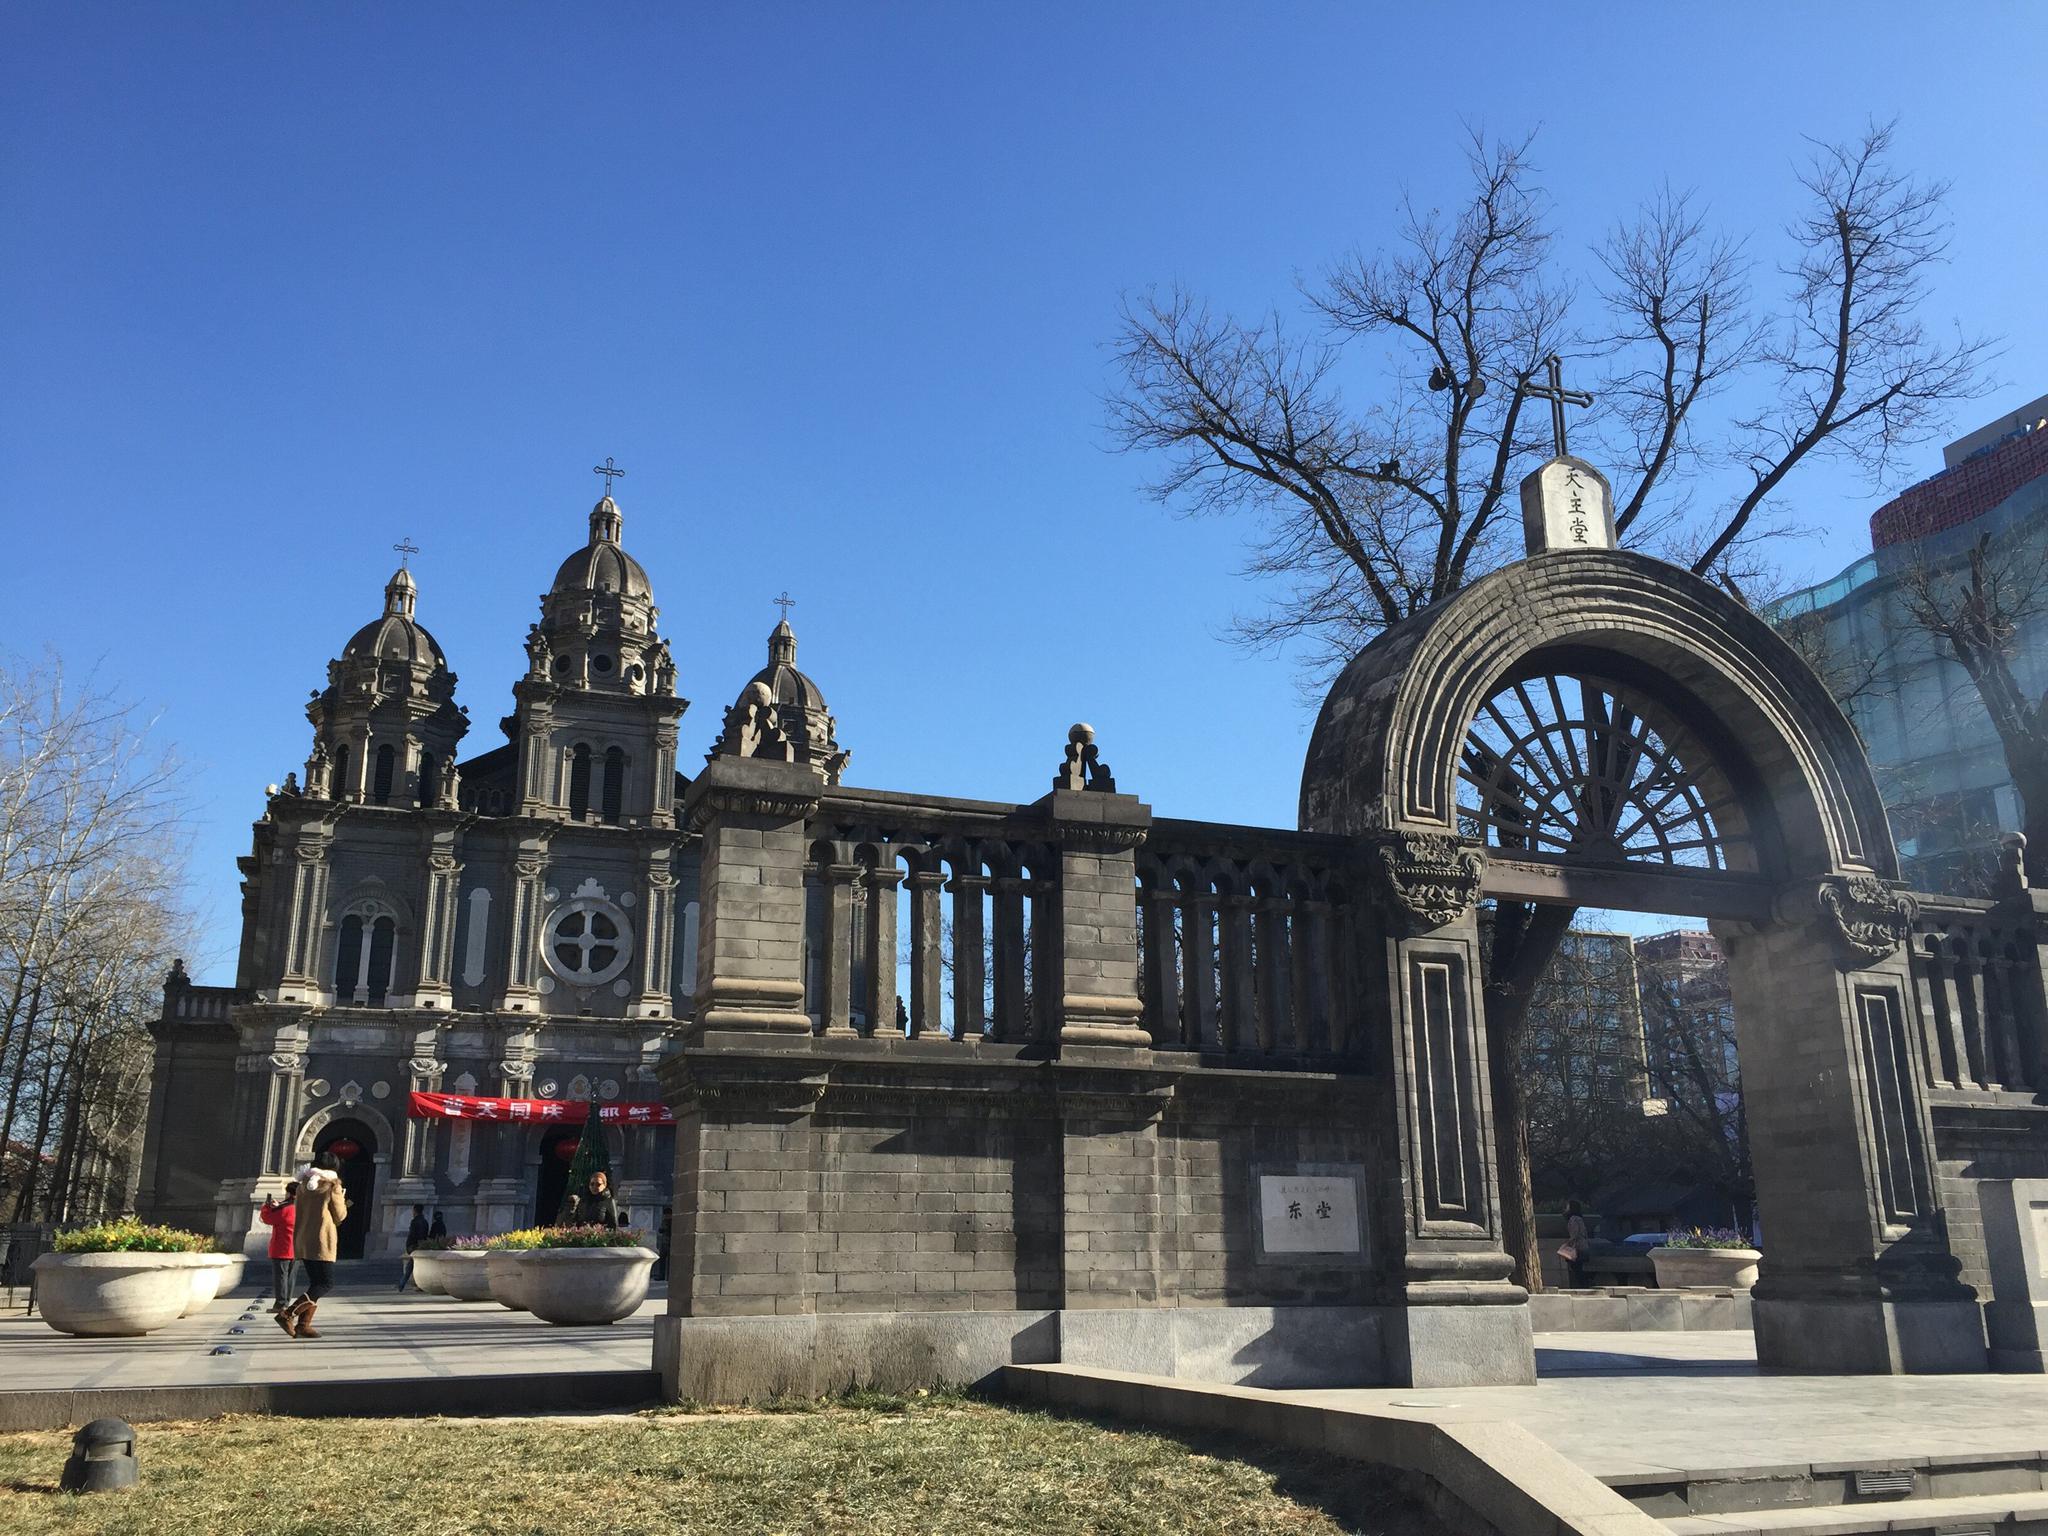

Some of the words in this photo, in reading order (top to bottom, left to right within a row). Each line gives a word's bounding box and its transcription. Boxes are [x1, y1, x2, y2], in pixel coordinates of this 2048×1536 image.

[1564, 467, 1588, 544] 天主堂
[443, 1098, 564, 1120] 普天同庆
[1288, 1200, 1332, 1219] 东堂
